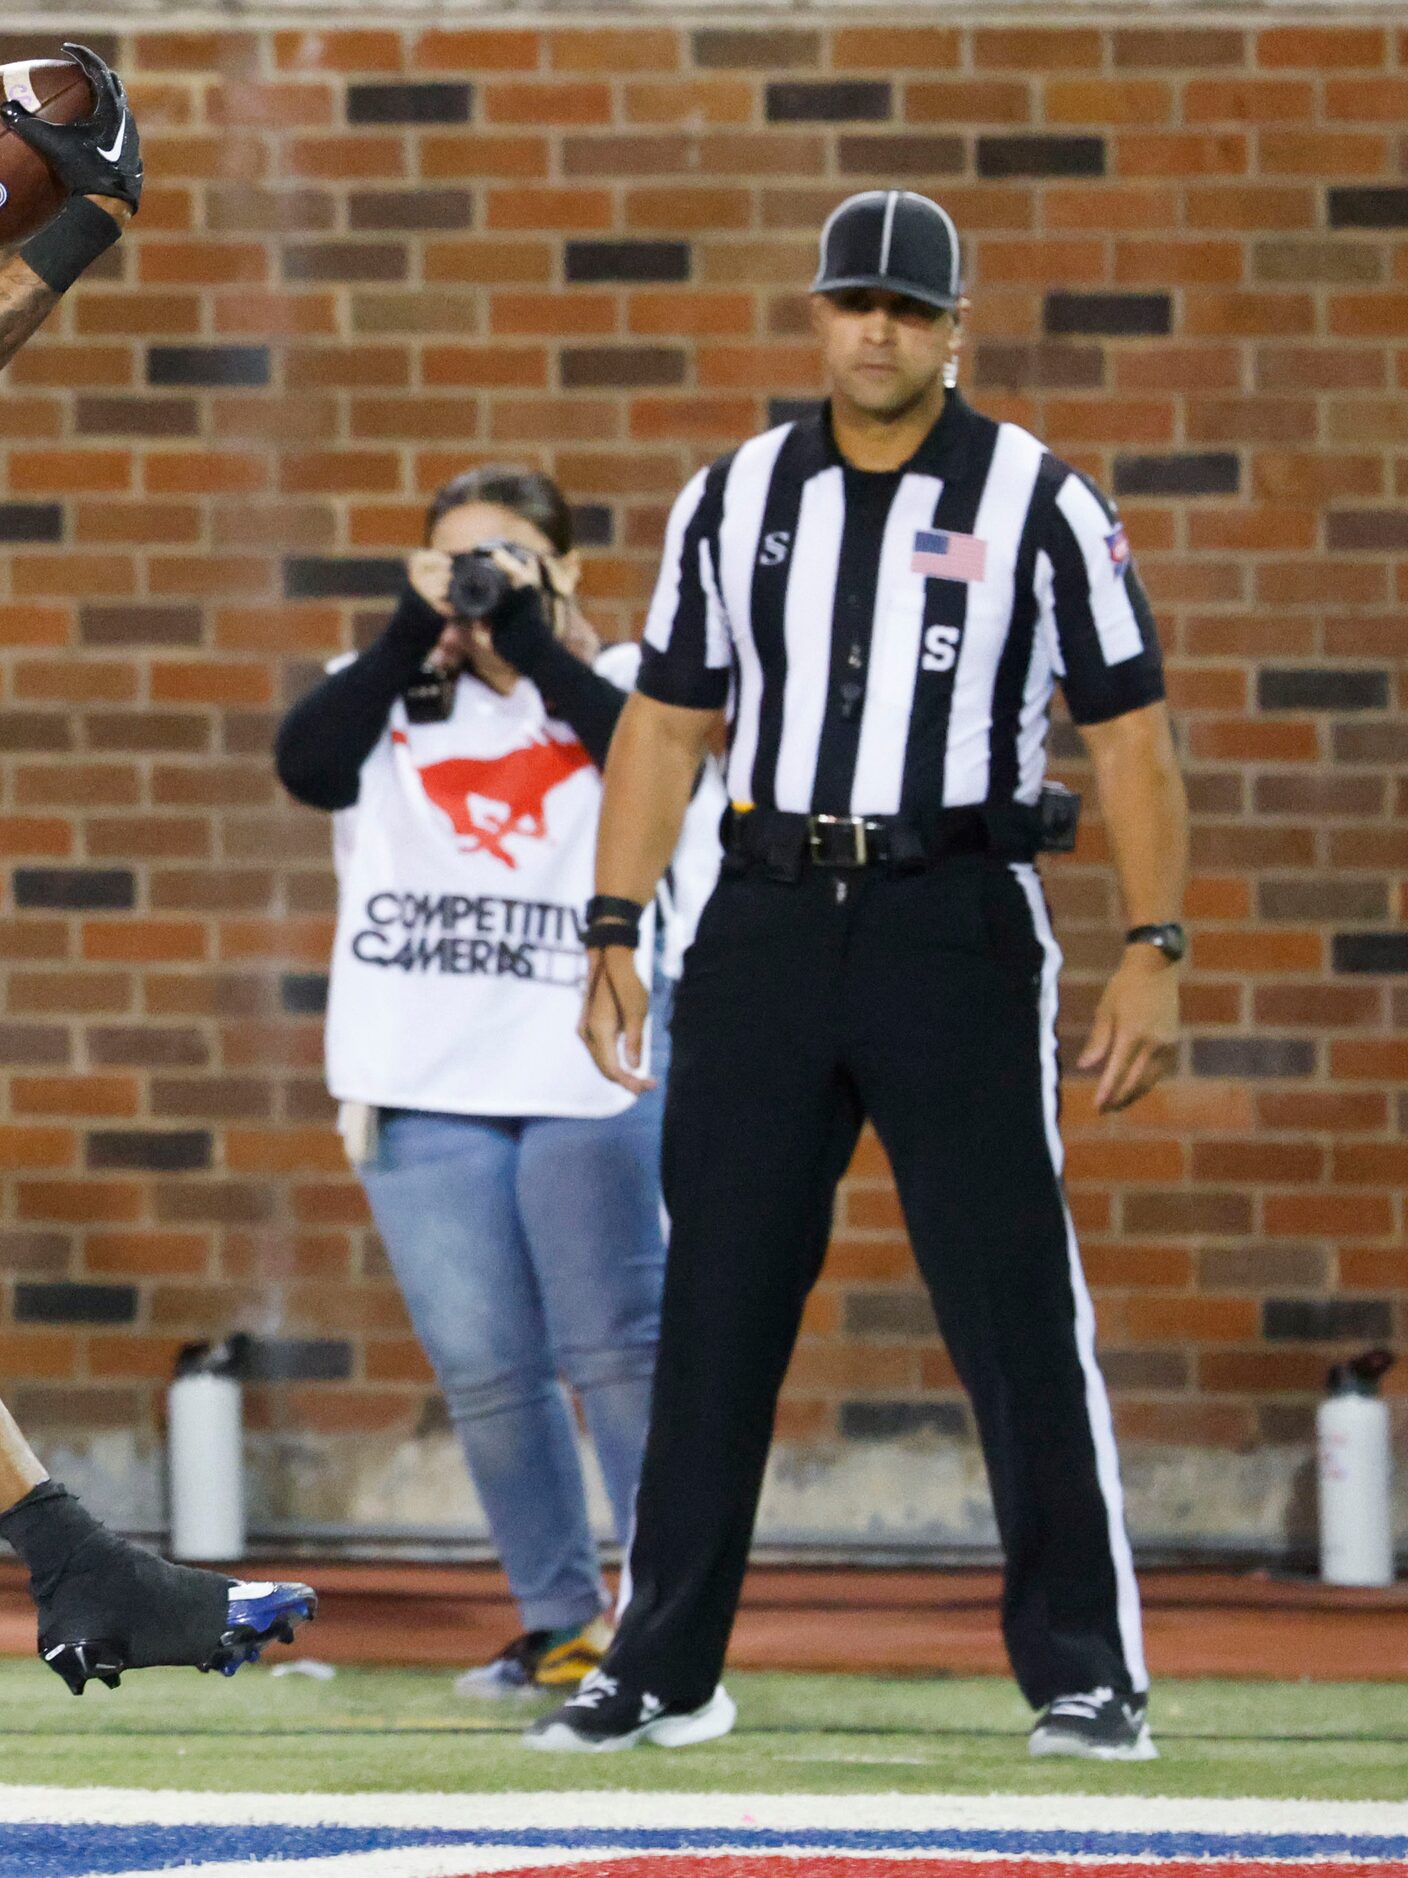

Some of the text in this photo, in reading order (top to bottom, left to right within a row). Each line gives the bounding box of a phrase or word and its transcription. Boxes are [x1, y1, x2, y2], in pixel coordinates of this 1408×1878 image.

[760, 532, 791, 565] S
[922, 625, 961, 672] S
[367, 893, 586, 942] COMPETITIV
[353, 931, 535, 979] CAMERAS
